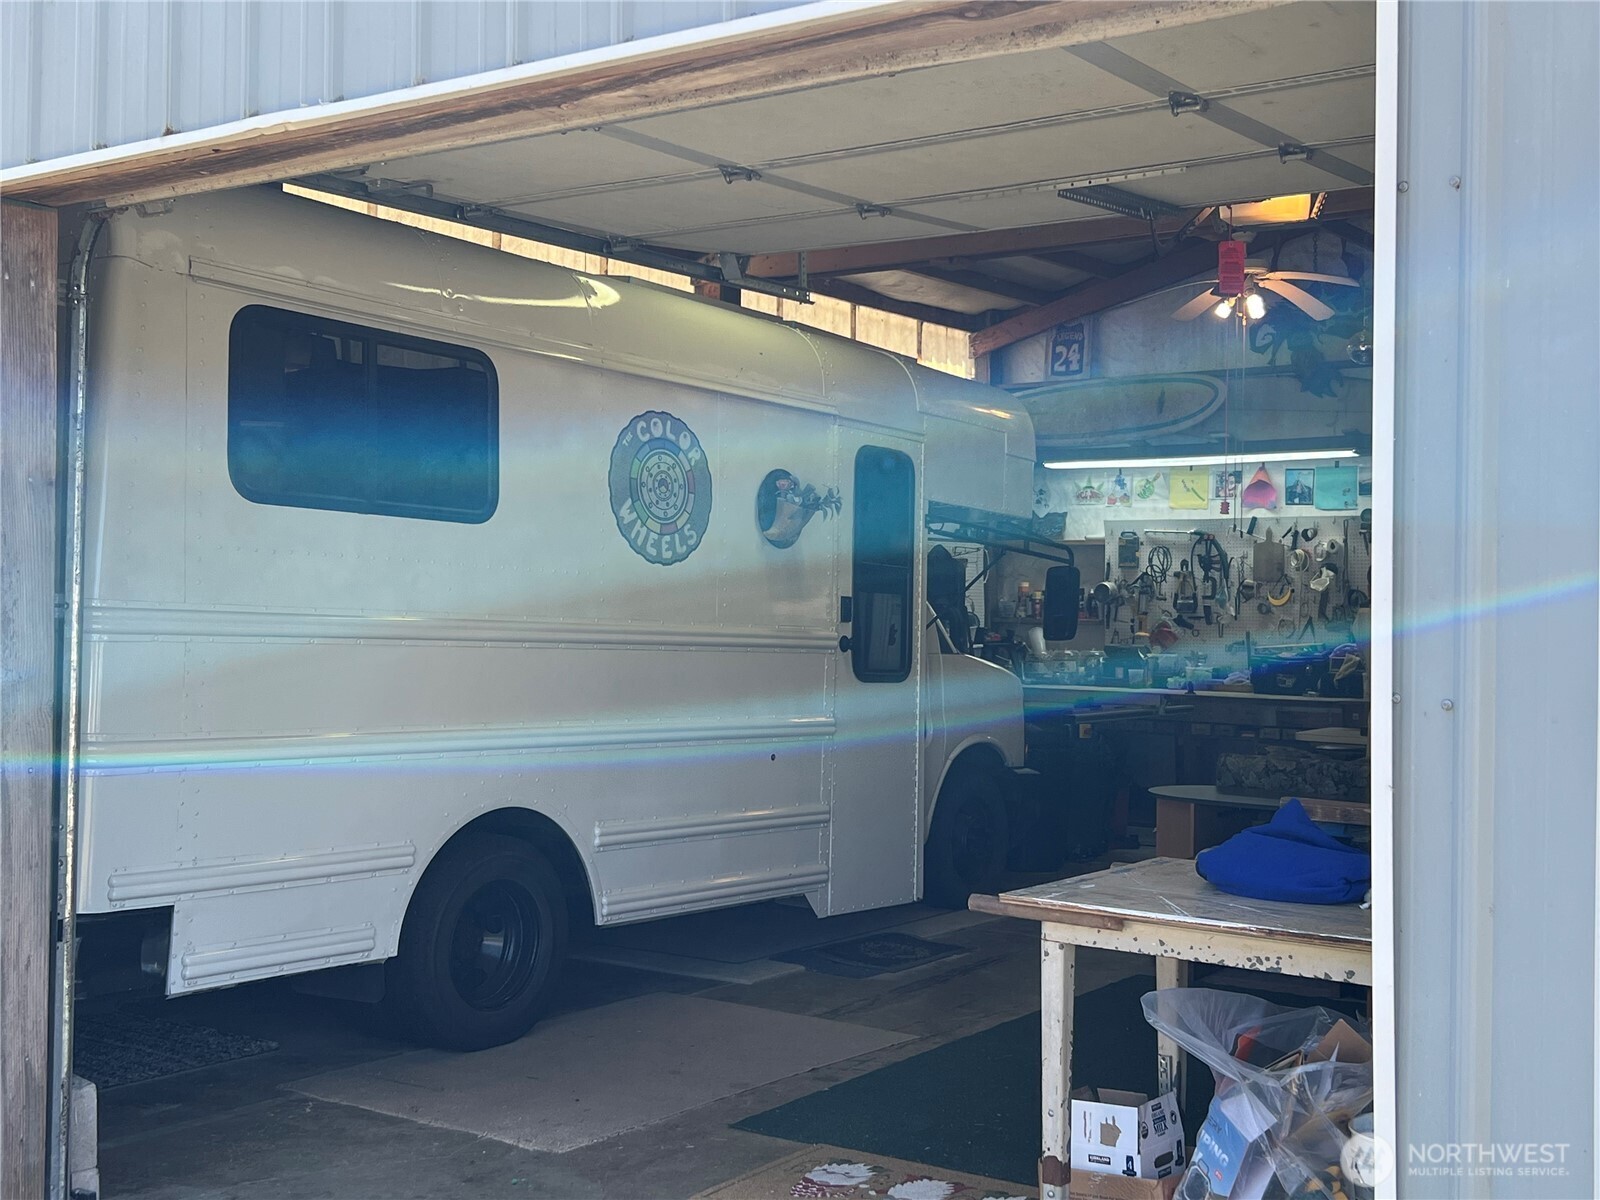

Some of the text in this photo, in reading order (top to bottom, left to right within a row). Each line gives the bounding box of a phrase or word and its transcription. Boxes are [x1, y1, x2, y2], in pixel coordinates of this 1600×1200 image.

[1053, 343, 1081, 373] 24
[636, 417, 702, 467] COLOR
[619, 497, 698, 559] WHEELS
